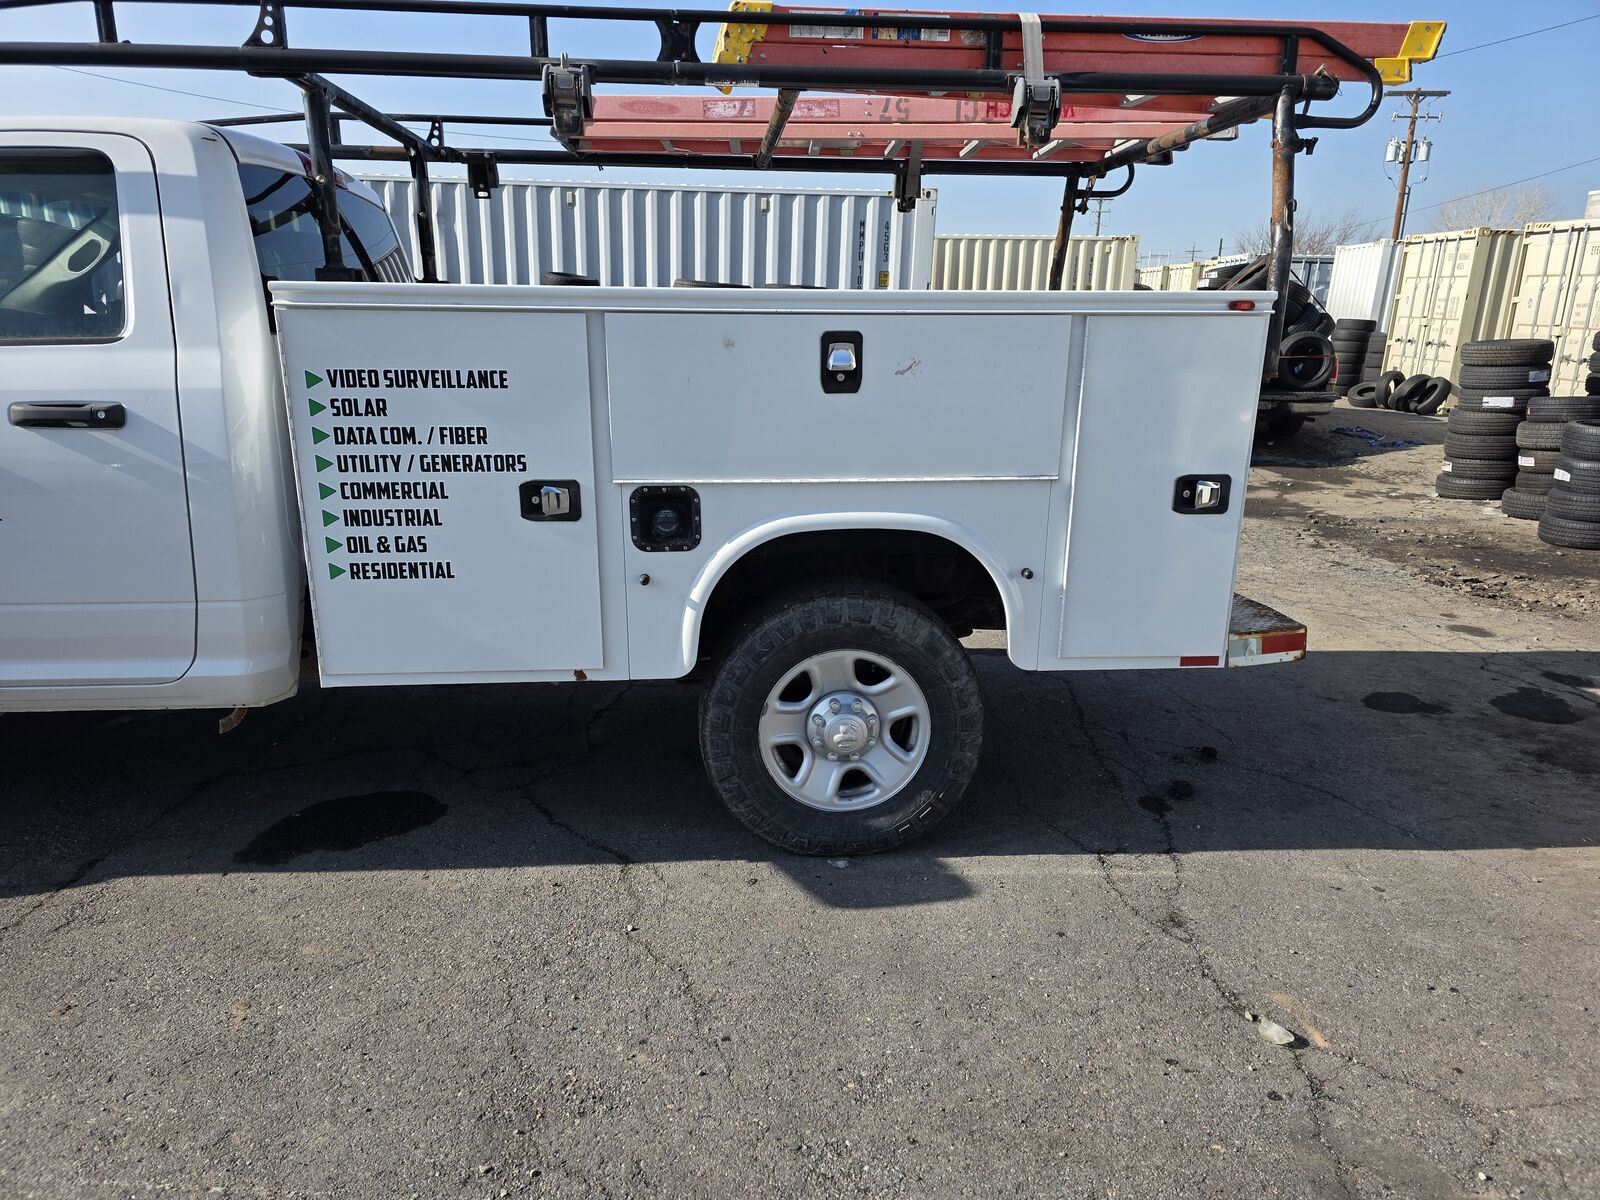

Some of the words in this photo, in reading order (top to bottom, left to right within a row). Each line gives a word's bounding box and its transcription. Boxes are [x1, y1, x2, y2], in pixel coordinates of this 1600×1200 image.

[326, 369, 380, 388] VIDEO
[383, 369, 508, 389] SURVEILLANCE
[330, 398, 387, 416] SOLAR
[333, 426, 377, 445] DATA
[380, 426, 422, 445] COM.
[427, 426, 434, 445] /
[439, 426, 488, 445] FIBER
[336, 454, 401, 473] UTILITY
[407, 454, 414, 473] /
[419, 454, 527, 473] GENERATORS
[340, 482, 449, 500] COMMERCIAL
[343, 509, 443, 527] INDUSTRIAL
[346, 536, 374, 554] OIL
[377, 536, 391, 554] &
[394, 536, 428, 553] GAS
[349, 562, 455, 580] RESIDENTIAL
